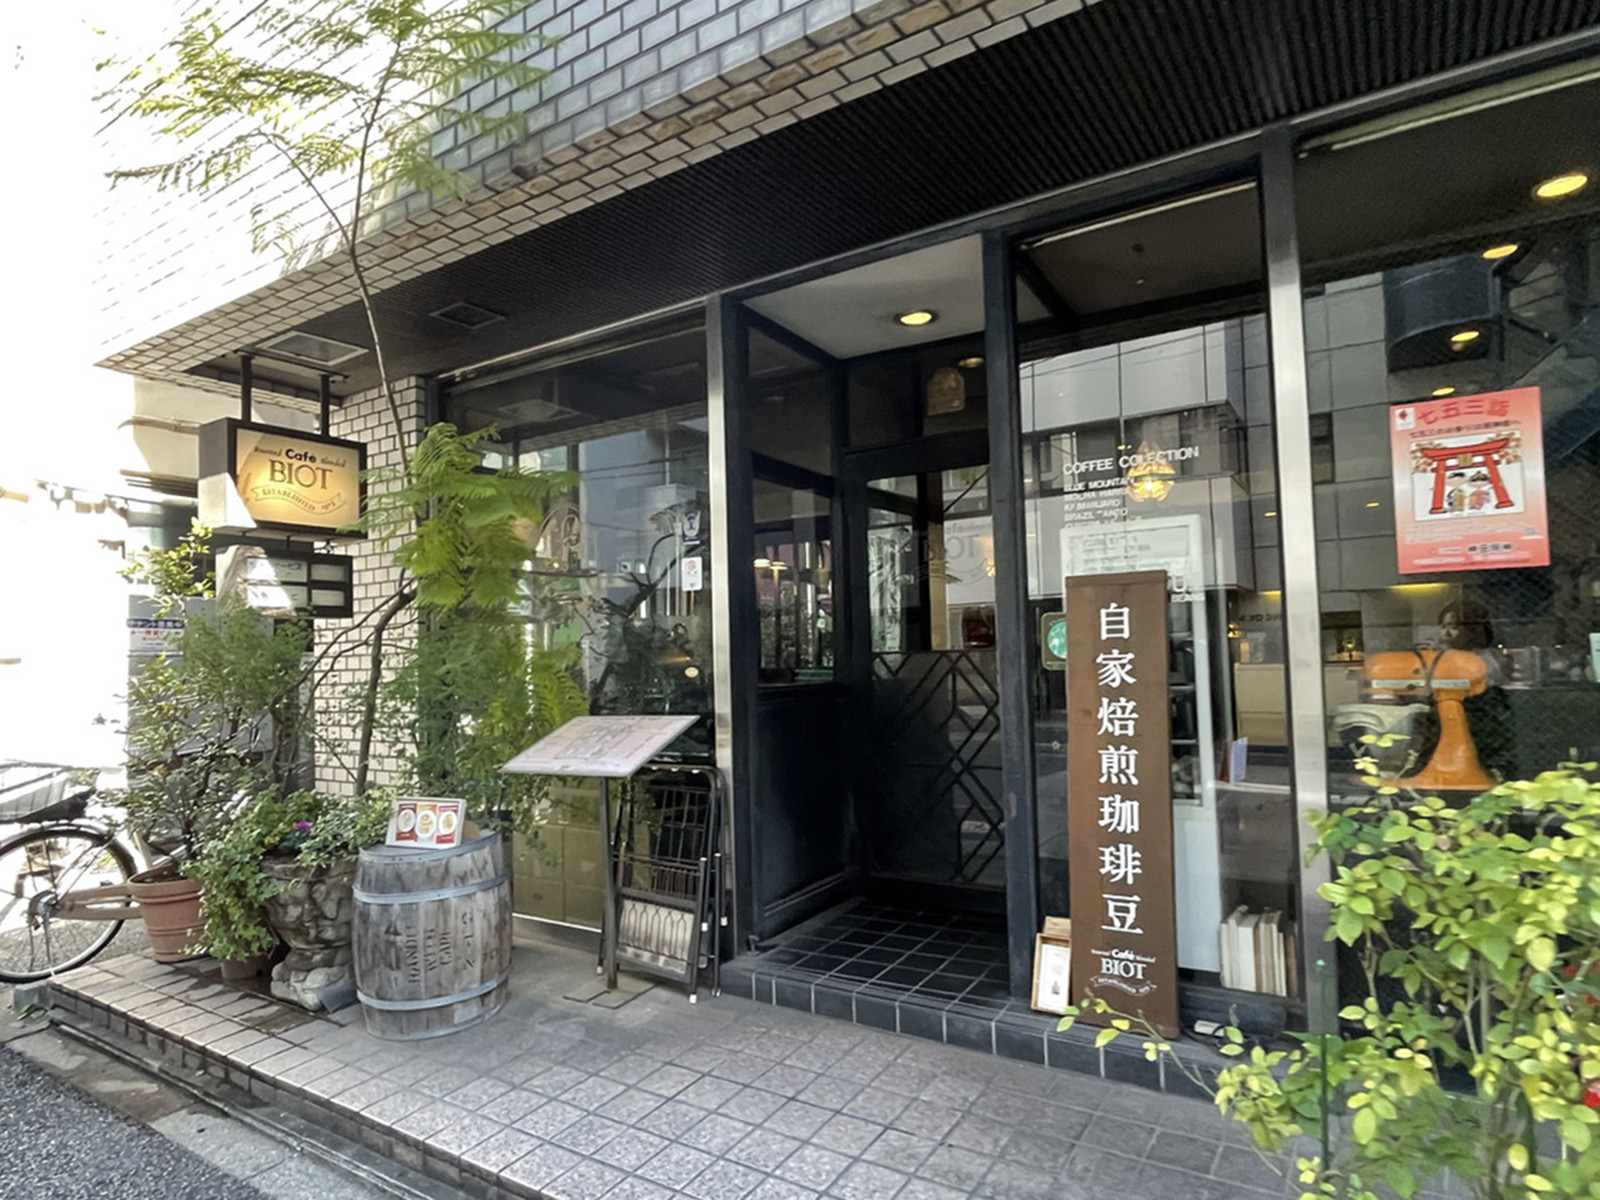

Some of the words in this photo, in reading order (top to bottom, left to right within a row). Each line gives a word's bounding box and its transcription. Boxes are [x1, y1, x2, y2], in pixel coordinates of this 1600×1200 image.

[268, 458, 333, 490] BIOT
[1063, 457, 1115, 475] COFFEE
[1096, 601, 1144, 936] 自家焙煎珈琲豆
[1100, 957, 1147, 980] BIOT
